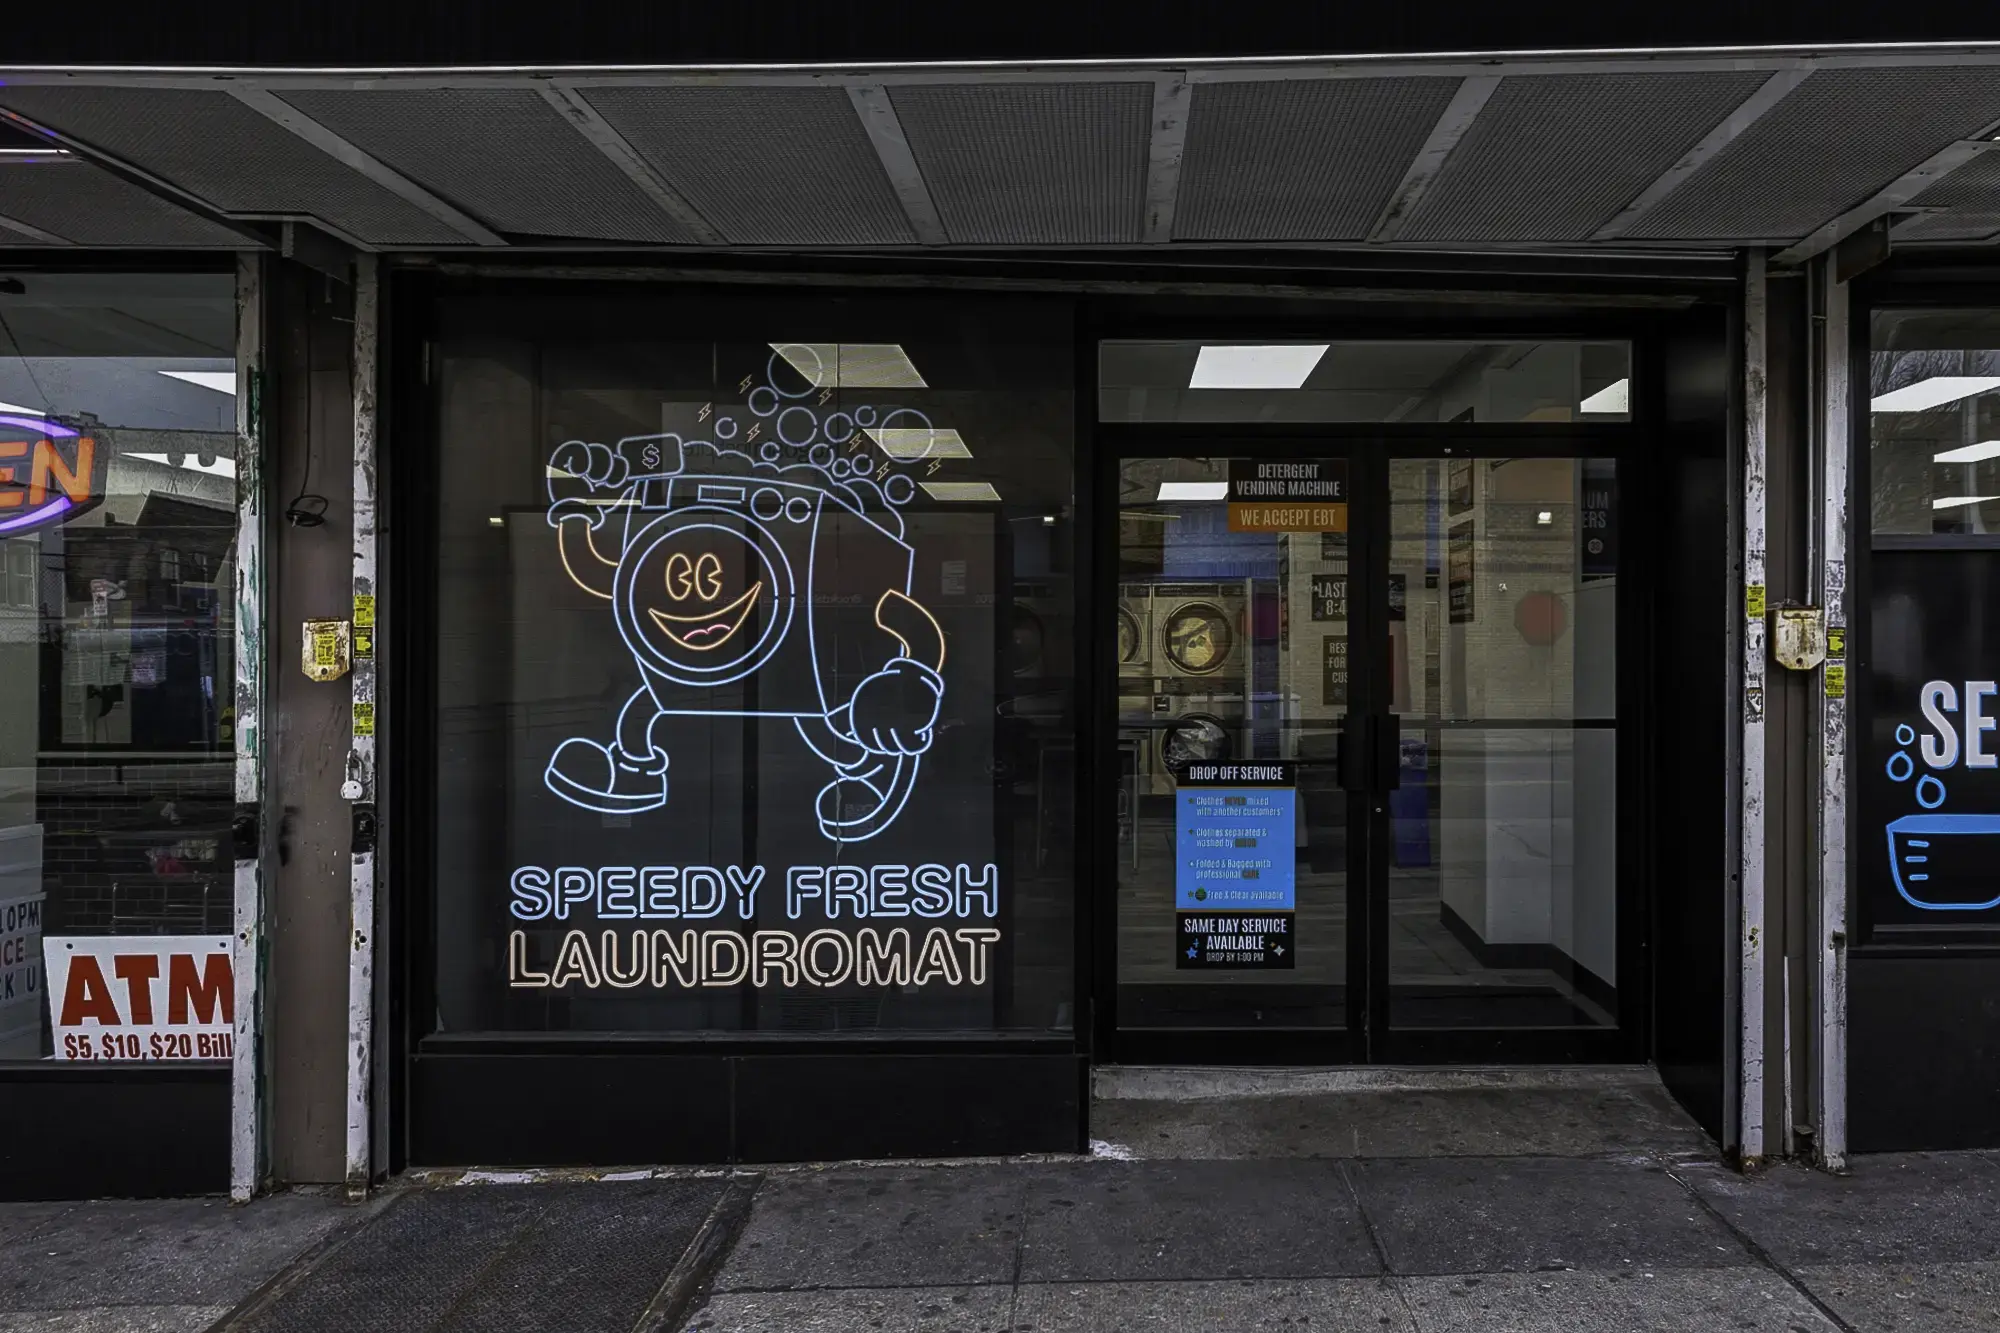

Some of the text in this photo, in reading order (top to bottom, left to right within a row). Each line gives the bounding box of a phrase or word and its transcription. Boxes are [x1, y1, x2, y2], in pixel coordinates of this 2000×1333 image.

[1258, 464, 1319, 478] DETERGENT
[1236, 481, 1340, 496] VENDING MACHINE
[1240, 509, 1335, 526] WE ACCEPT EBT
[1318, 582, 1347, 598] LAST
[1920, 680, 1998, 770] SE
[1189, 766, 1284, 780] DROP OFF SERVICE
[510, 863, 999, 921] SPEEDY FRESH
[1184, 918, 1287, 933] SAME DAY SERVICE
[1206, 935, 1265, 950] AVAILABLE
[510, 927, 1001, 989] LAUNDROMAT
[1206, 952, 1224, 962] DROP
[1226, 952, 1235, 962] BY
[1253, 952, 1264, 962] PM
[59, 953, 234, 1026] ATM
